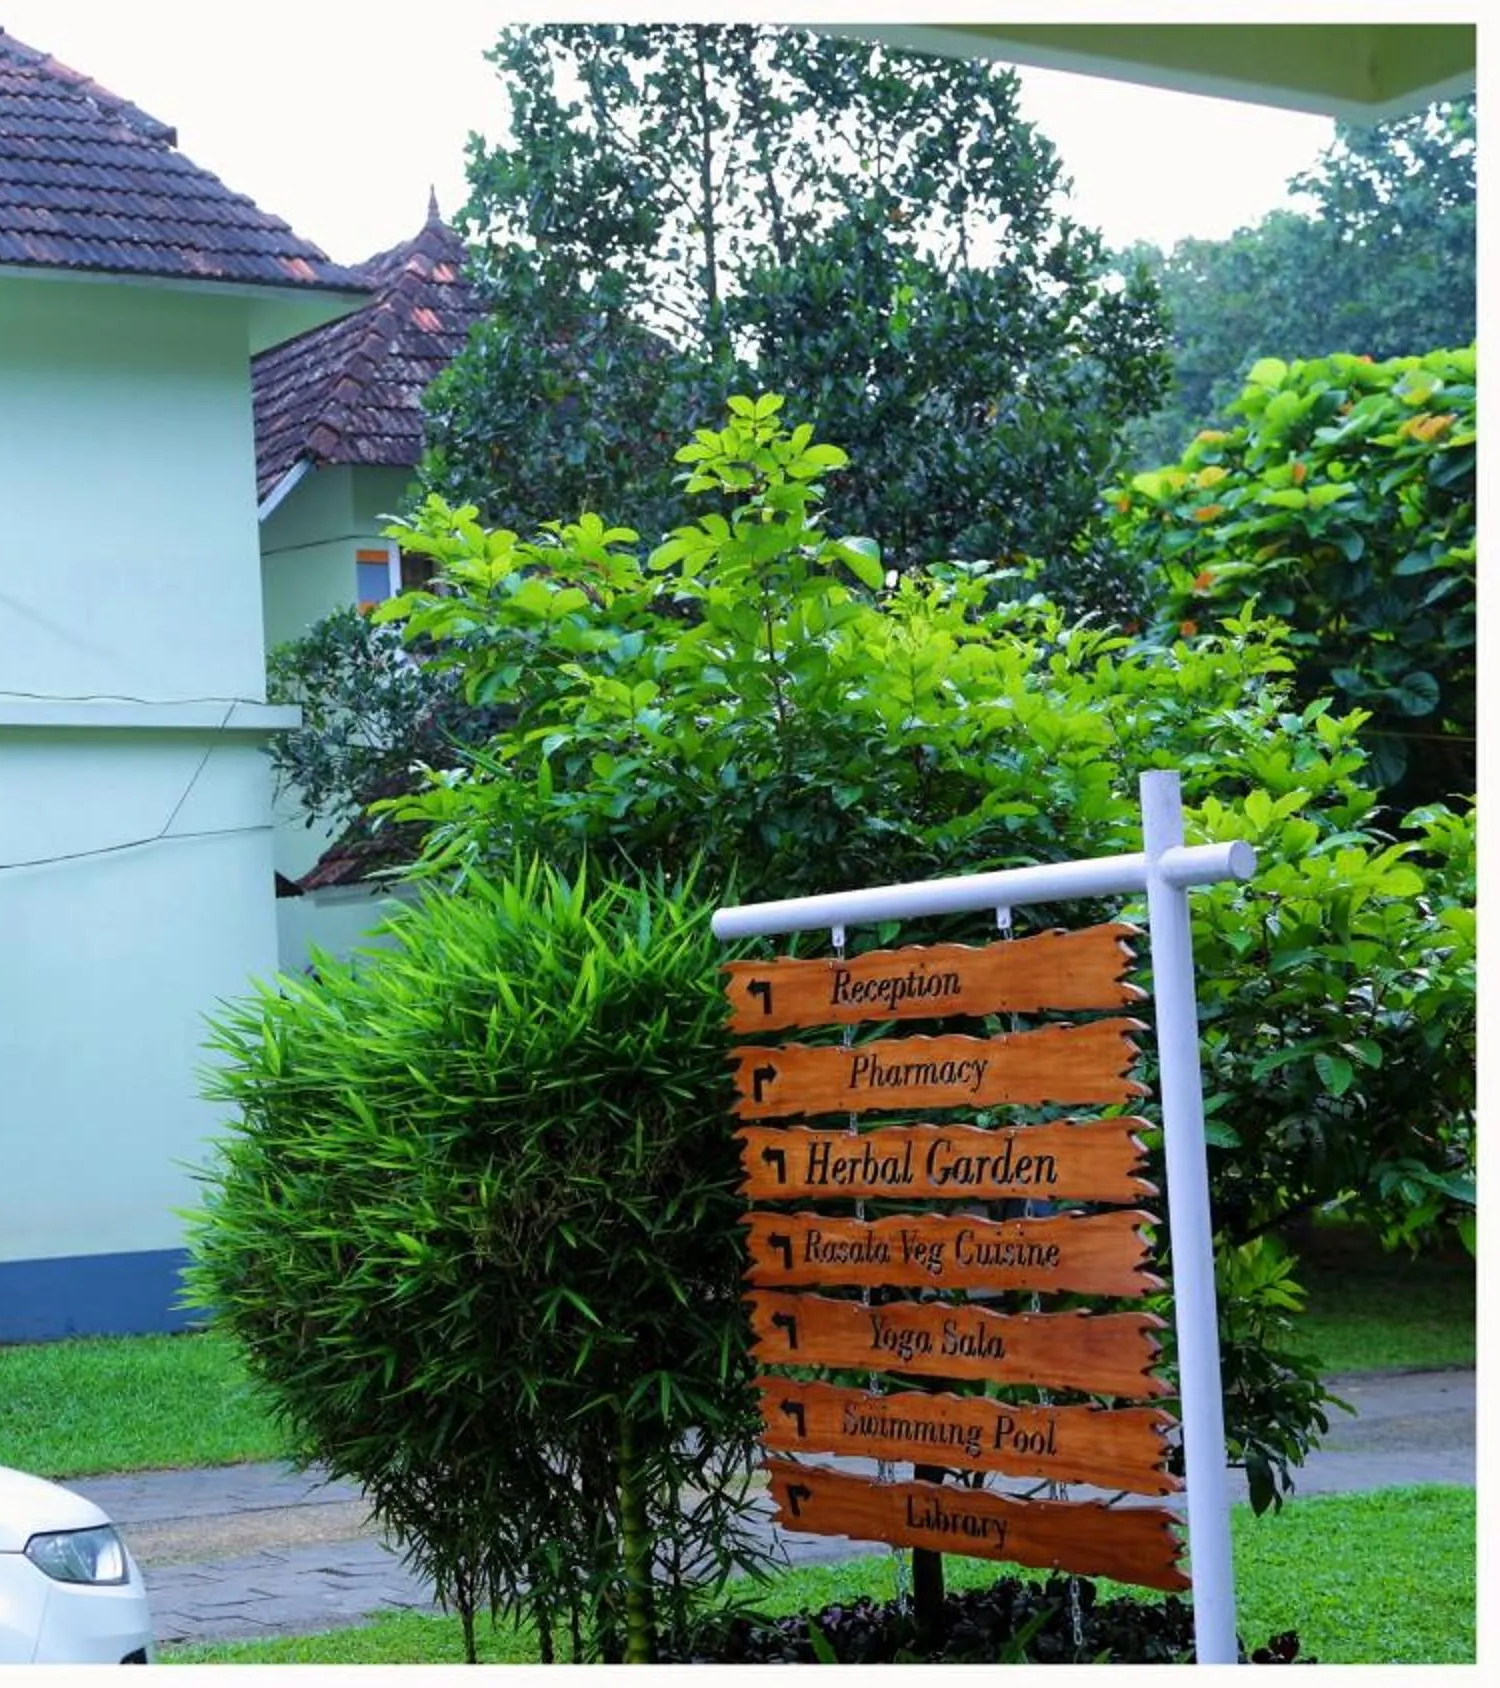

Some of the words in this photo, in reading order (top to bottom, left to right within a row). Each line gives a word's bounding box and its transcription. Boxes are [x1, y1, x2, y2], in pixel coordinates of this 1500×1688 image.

[831, 964, 961, 1009] Reception
[849, 1053, 989, 1093] Pharmacy
[804, 1140, 914, 1185] Herbal
[926, 1138, 1058, 1186] Garden
[900, 1231, 945, 1275] Veg
[954, 1231, 1061, 1268] Cuisine
[868, 1313, 933, 1361] Yoga
[941, 1320, 1006, 1359] Sala
[842, 1405, 983, 1457] Swimming
[993, 1416, 1058, 1456] Pool
[905, 1494, 1009, 1550] Library
